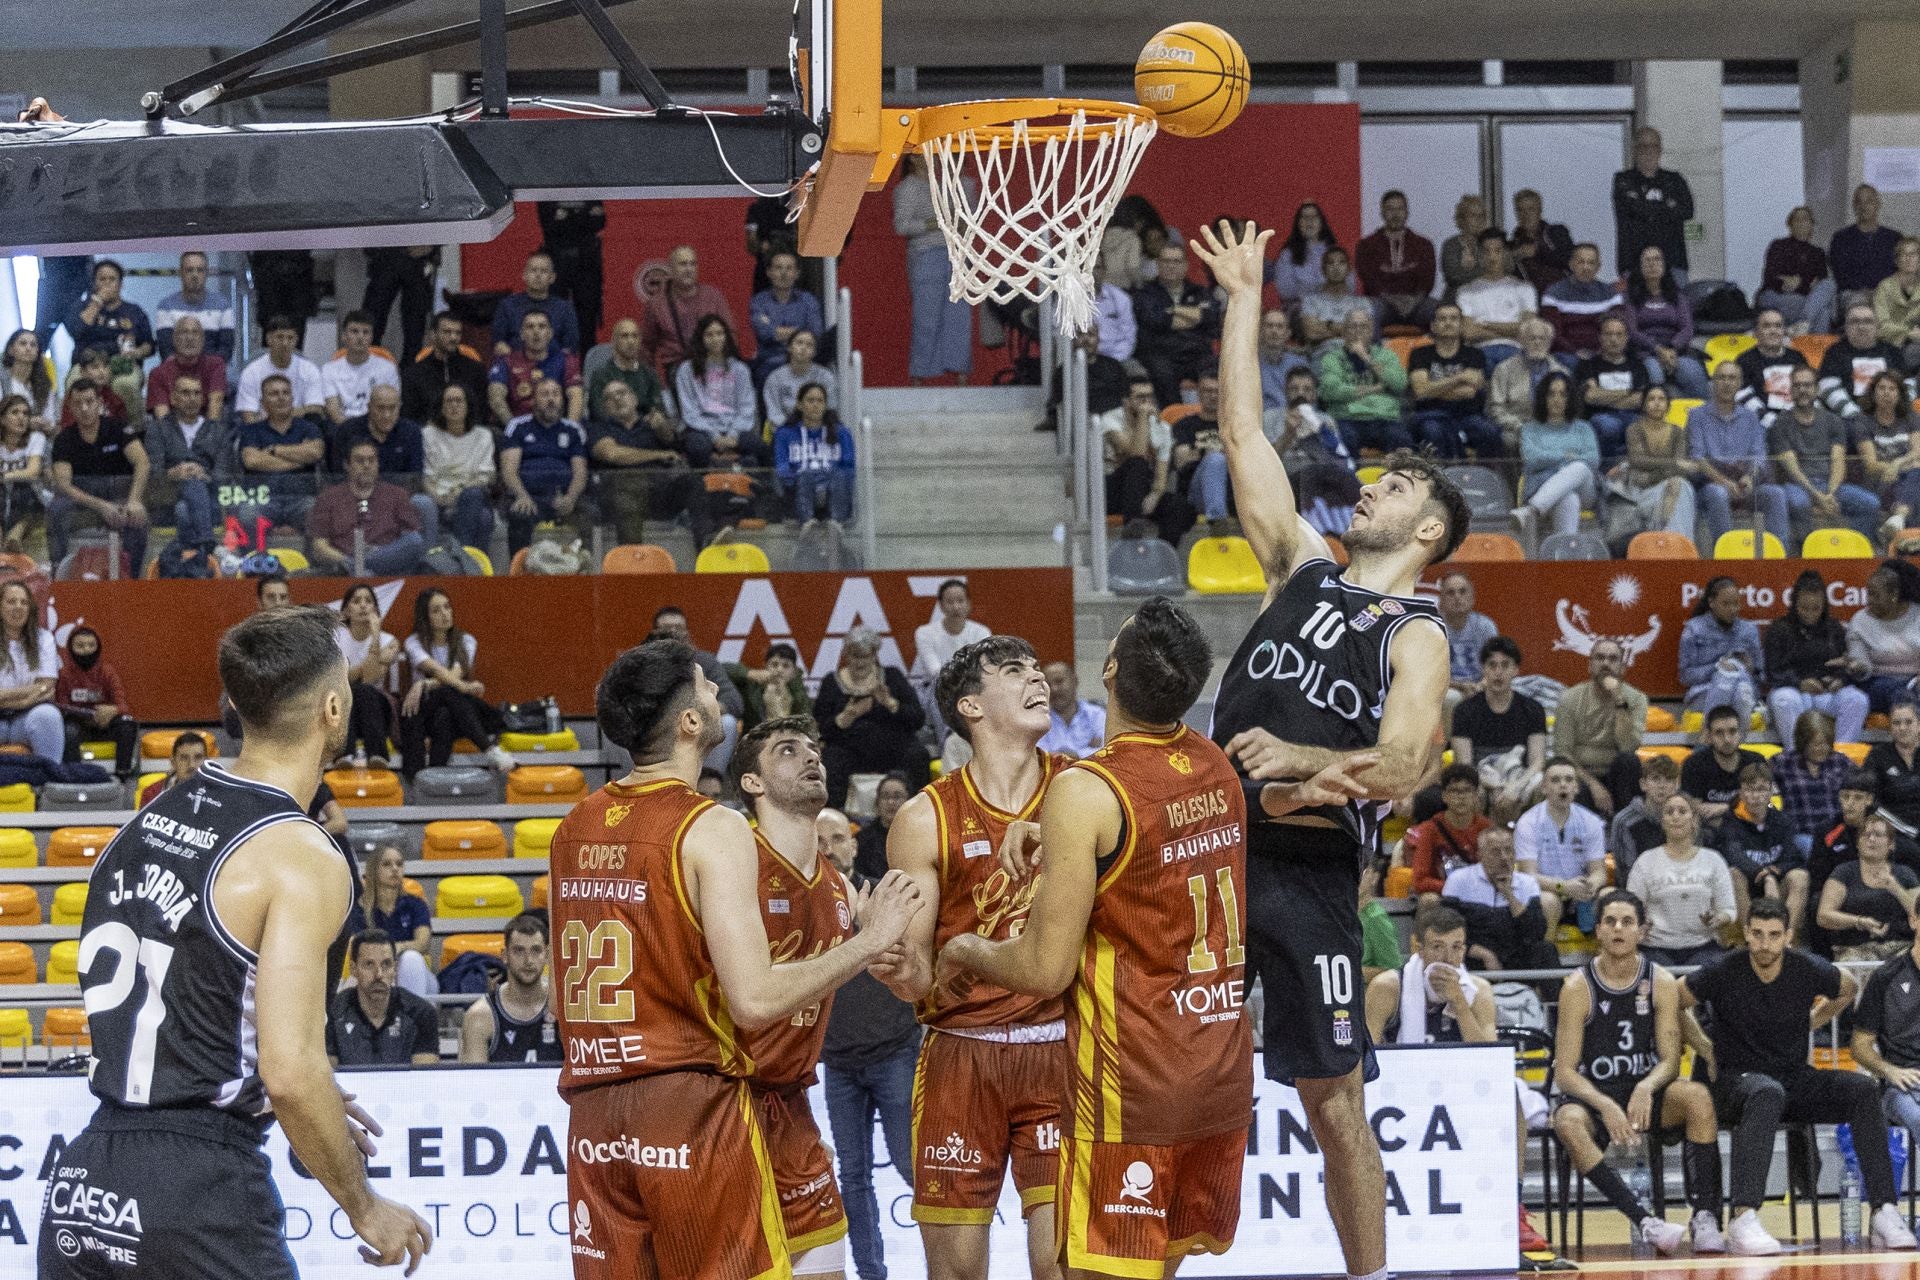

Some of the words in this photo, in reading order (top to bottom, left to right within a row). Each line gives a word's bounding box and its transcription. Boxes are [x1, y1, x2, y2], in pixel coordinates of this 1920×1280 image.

[1299, 601, 1346, 650] 10
[1248, 640, 1362, 720] ODILO
[1166, 790, 1228, 828] IGLESIAS
[579, 845, 627, 870] COPES
[1163, 829, 1240, 863] BAUHAUS
[561, 880, 647, 901] BAUHAUS
[1187, 866, 1246, 974] 11
[561, 919, 635, 1022] 22
[1314, 955, 1353, 1004] 10
[569, 1035, 647, 1064] OMEE
[1617, 1020, 1634, 1050] 3
[578, 1134, 691, 1169] Occident
[58, 1167, 88, 1179] GRUPO
[51, 1181, 144, 1233] CAESA
[1104, 1204, 1166, 1217] IBERCARGAS
